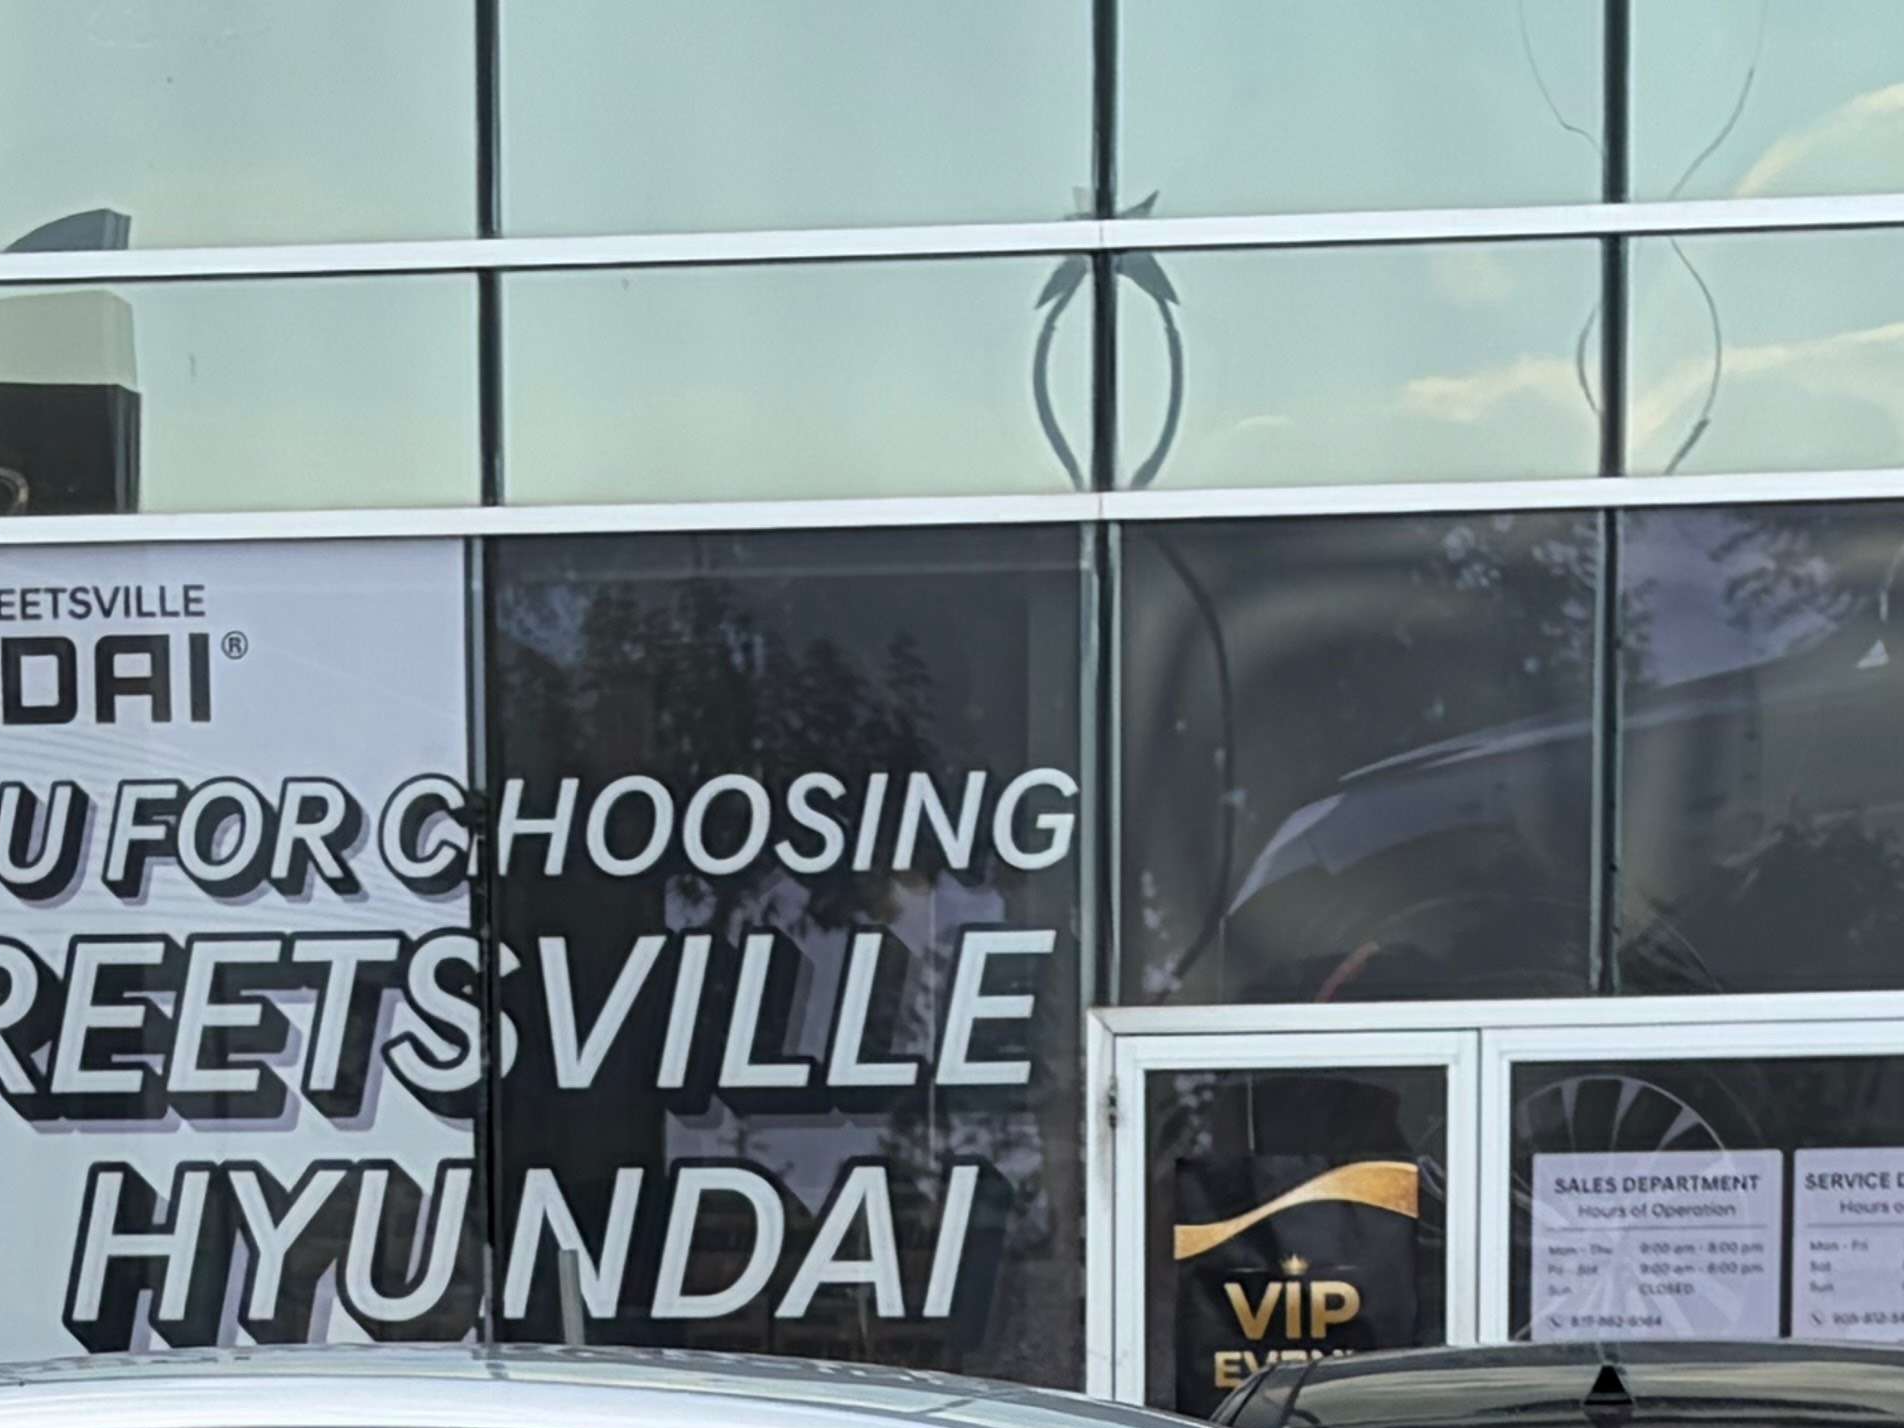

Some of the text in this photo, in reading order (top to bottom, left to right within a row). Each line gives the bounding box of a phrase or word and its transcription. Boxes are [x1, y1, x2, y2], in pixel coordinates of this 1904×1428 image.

[100, 774, 358, 898] FOR
[380, 768, 1080, 882] CHOOSING
[1553, 1174, 1761, 1195] SALES DEPARTMENT
[1804, 1172, 1891, 1191] SERVICE
[1577, 1202, 1737, 1219] Hours of Operation
[1839, 1201, 1890, 1214] Hours
[64, 1158, 982, 1342] HYUNDAI
[1674, 1244, 1695, 1255] am
[1741, 1243, 1765, 1256] pm
[1809, 1240, 1839, 1252] Mon
[1673, 1264, 1695, 1275] am
[1740, 1263, 1765, 1277] pm
[1638, 1282, 1695, 1297] CLOSED
[1223, 1280, 1361, 1342] VIP
